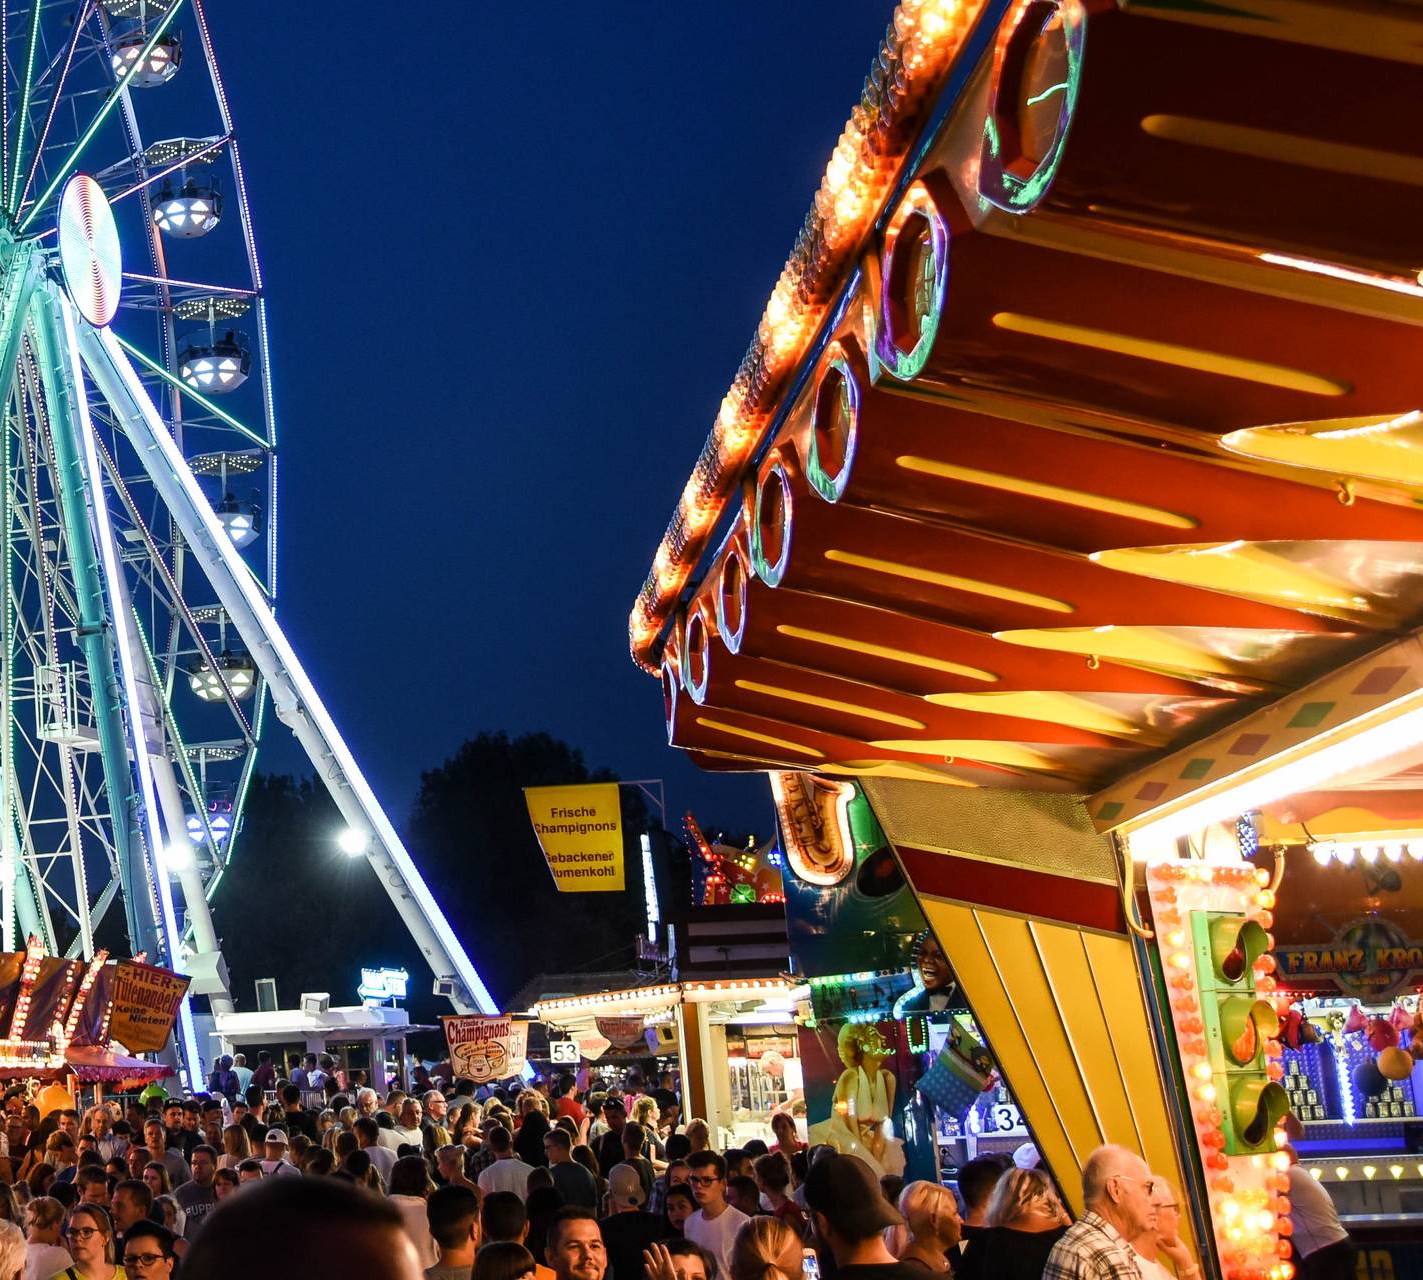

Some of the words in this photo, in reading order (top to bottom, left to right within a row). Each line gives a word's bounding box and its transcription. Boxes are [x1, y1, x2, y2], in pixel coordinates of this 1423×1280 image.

[550, 806, 597, 819] Frische
[535, 822, 617, 835] Champignons
[553, 865, 616, 878] lumenkohl
[1286, 949, 1366, 972] FRANZ
[132, 968, 175, 989] HIER
[115, 1003, 148, 1015] Keine
[128, 1012, 171, 1026] Nieten!
[447, 1021, 510, 1045] Champignons
[553, 1044, 578, 1062] 53
